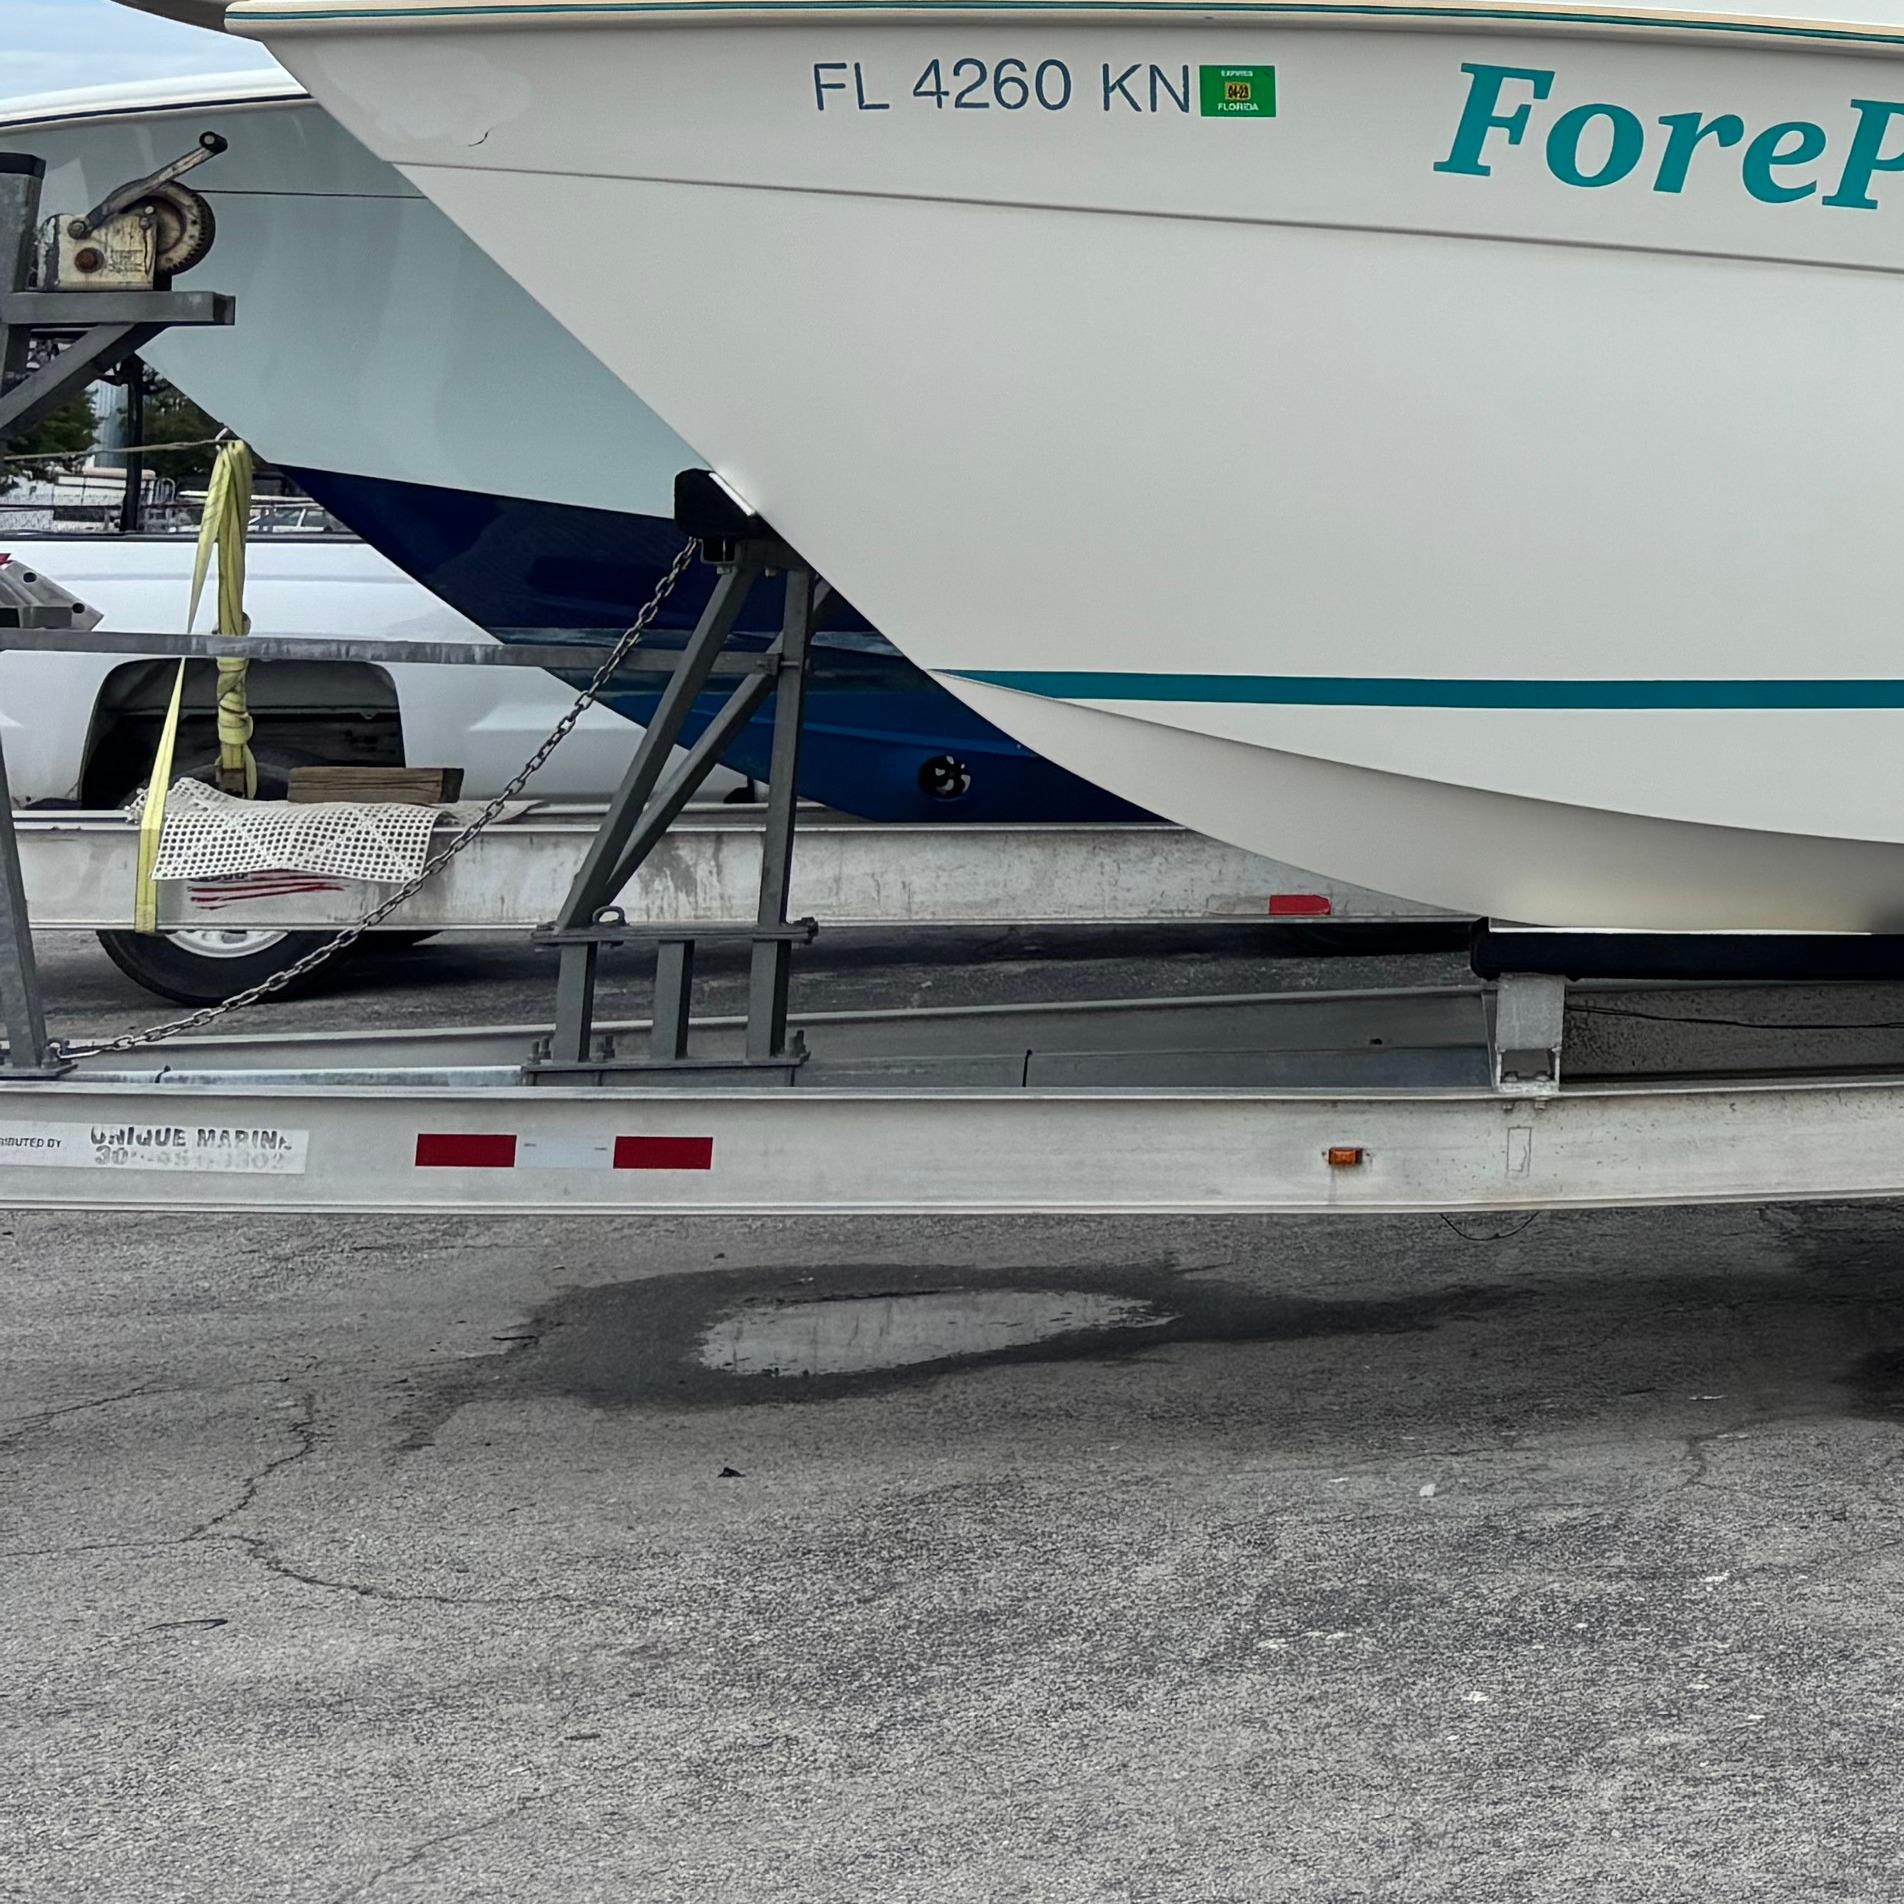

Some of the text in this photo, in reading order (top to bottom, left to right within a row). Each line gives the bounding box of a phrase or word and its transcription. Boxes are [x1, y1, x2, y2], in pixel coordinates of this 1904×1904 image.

[813, 57, 1190, 114] FL 4260 KN
[1217, 102, 1259, 111] FLORIDA
[47, 1138, 61, 1148] BY
